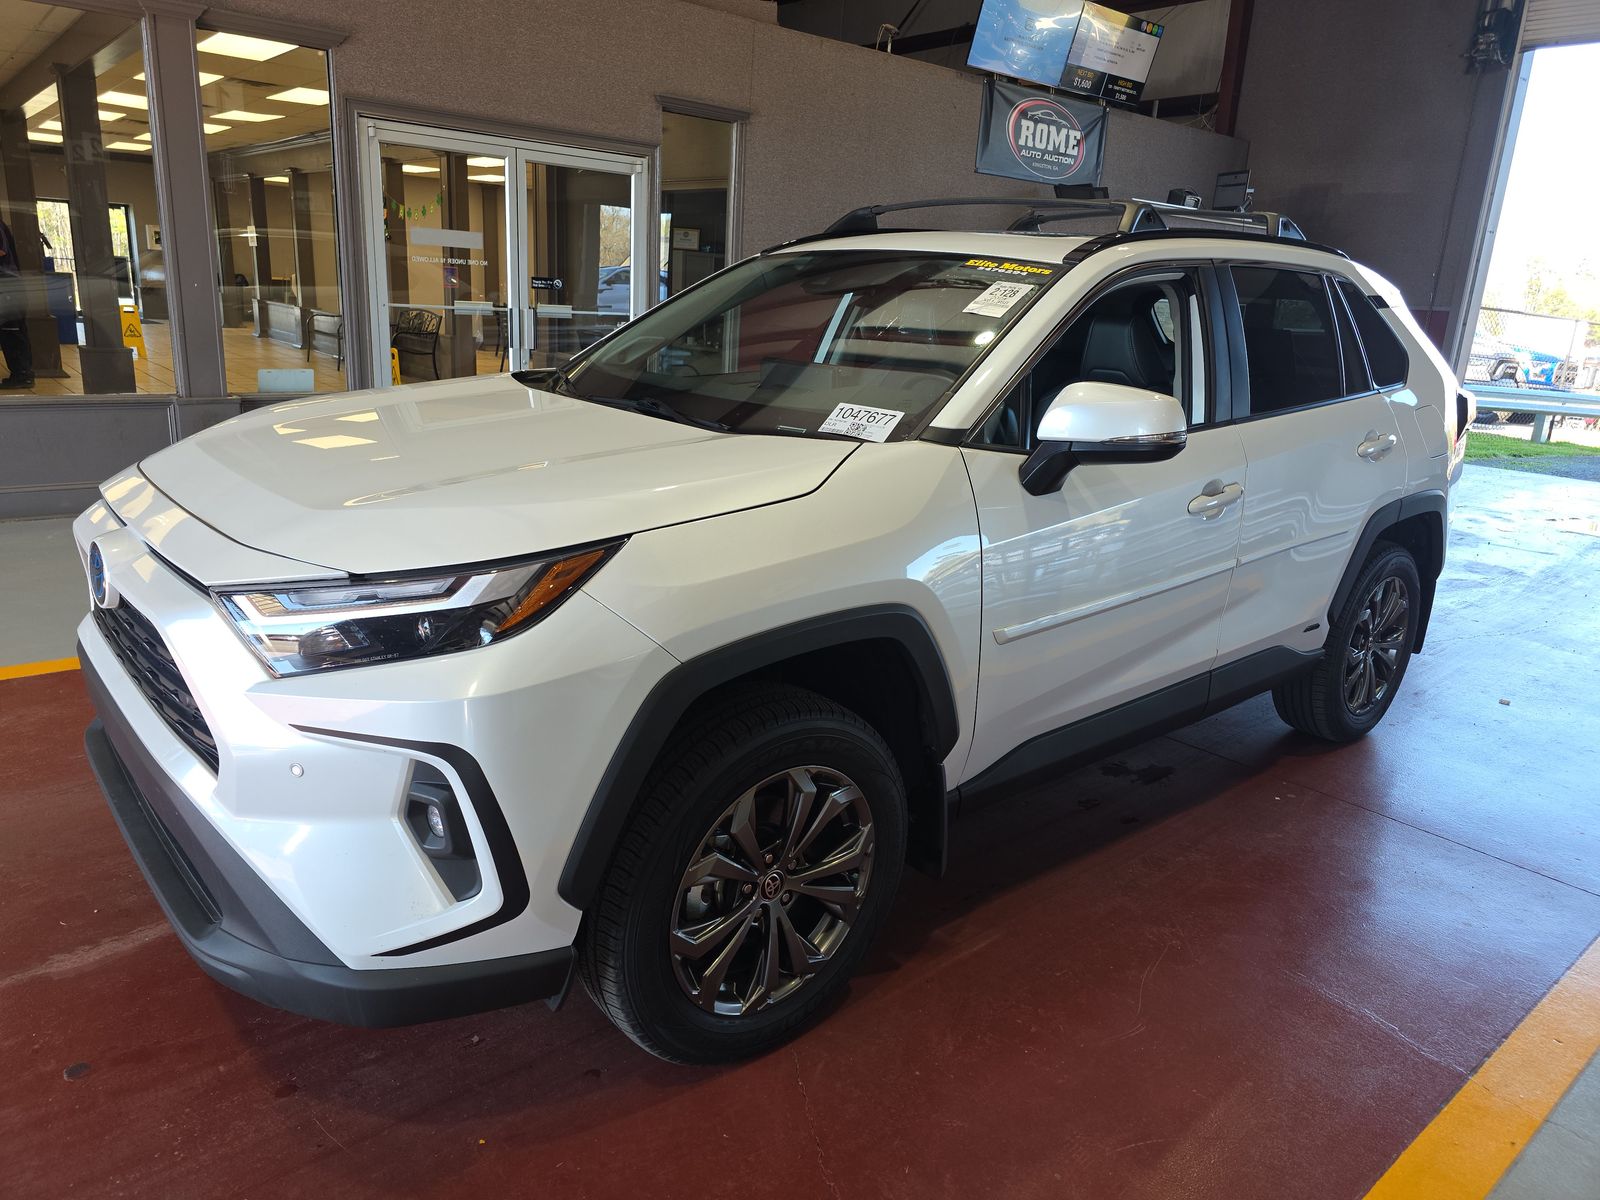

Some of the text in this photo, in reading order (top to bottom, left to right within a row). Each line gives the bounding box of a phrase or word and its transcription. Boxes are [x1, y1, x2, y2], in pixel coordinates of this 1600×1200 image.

[1073, 78, 1092, 88] $1,600
[1019, 119, 1081, 156] ROME
[1020, 149, 1075, 165] AUTO AUCTION
[965, 259, 1053, 275] Elite Motors
[835, 406, 897, 426] 1047677
